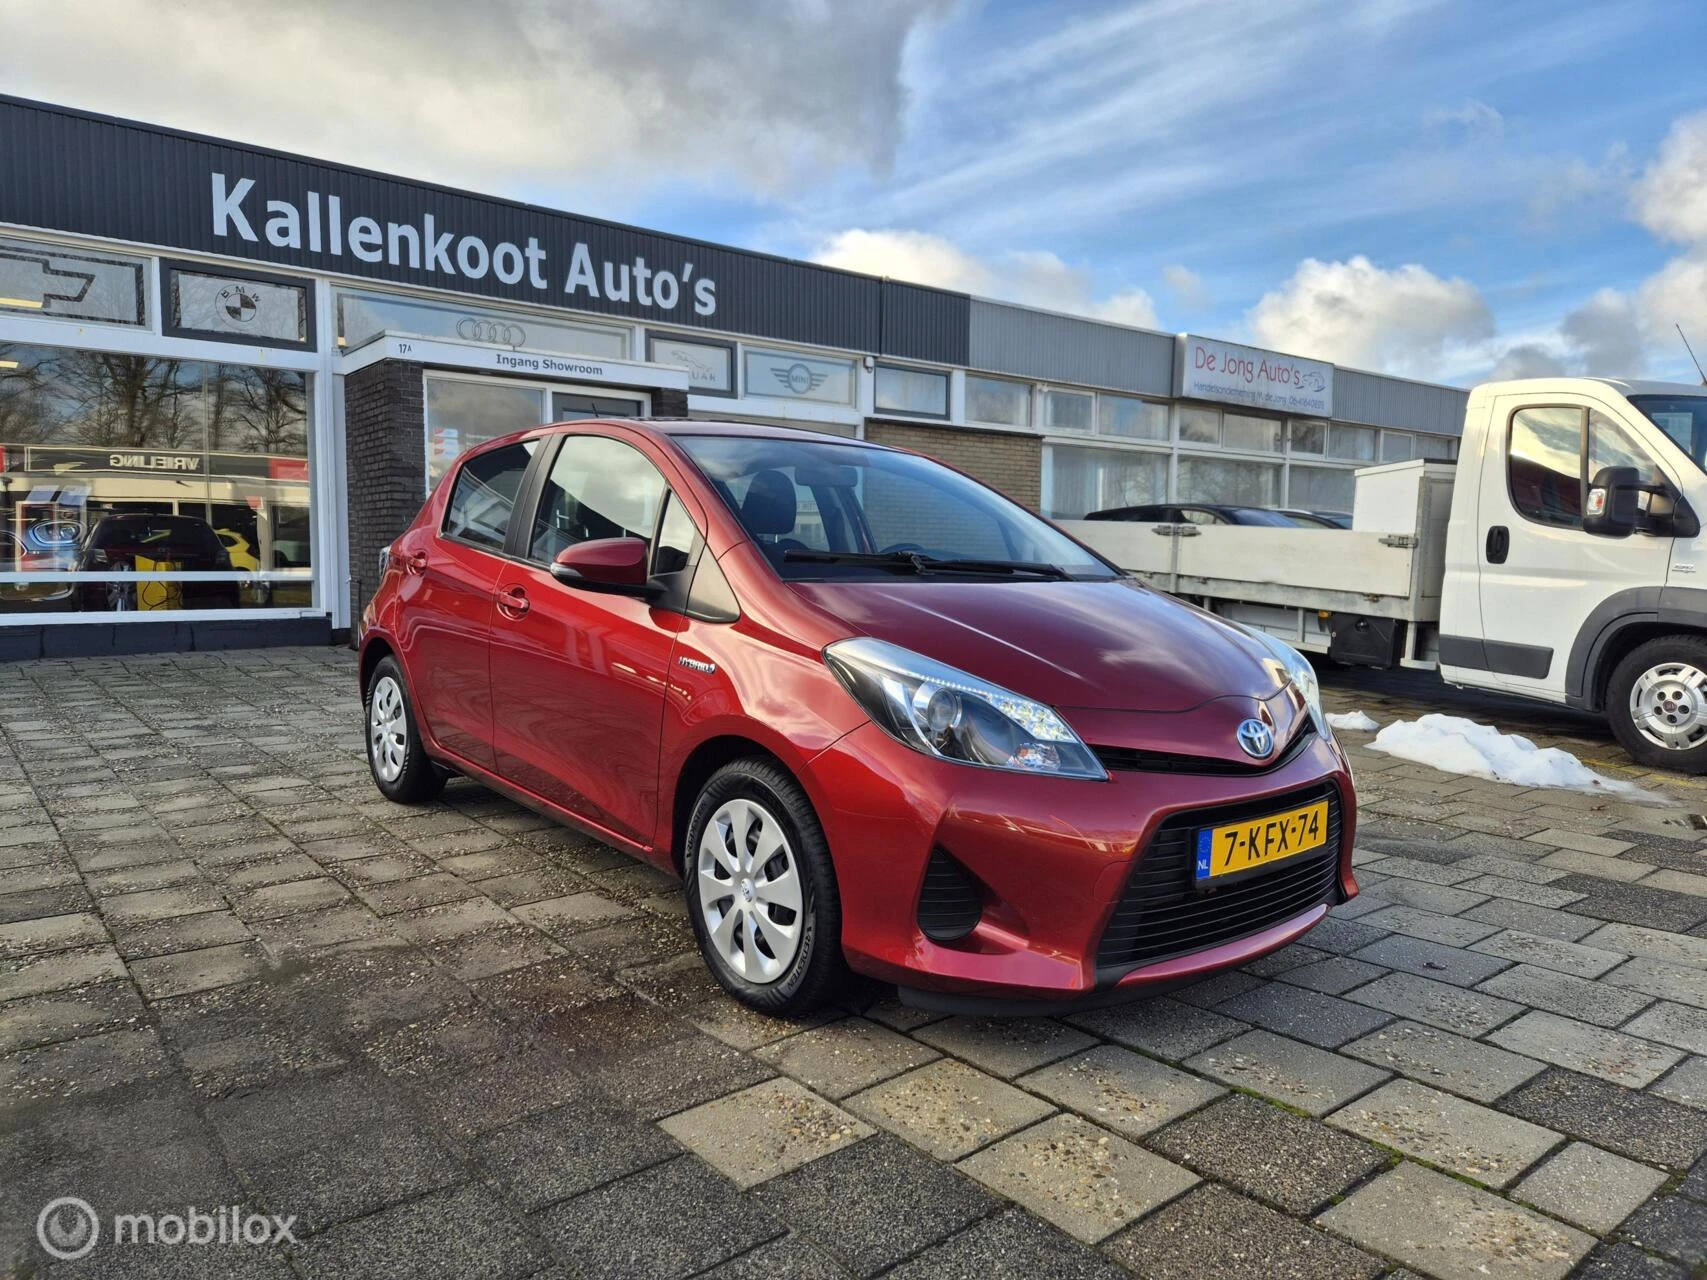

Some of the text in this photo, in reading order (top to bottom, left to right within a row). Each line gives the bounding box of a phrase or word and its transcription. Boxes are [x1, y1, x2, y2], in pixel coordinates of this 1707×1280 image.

[212, 173, 716, 316] Kallenkoot Auto's
[220, 285, 261, 302] BMW
[496, 354, 603, 375] Ingang Showroom
[1195, 346, 1301, 386] De Jong Auto's
[1225, 810, 1319, 866] 7-KFX-74
[1197, 859, 1209, 871] NL
